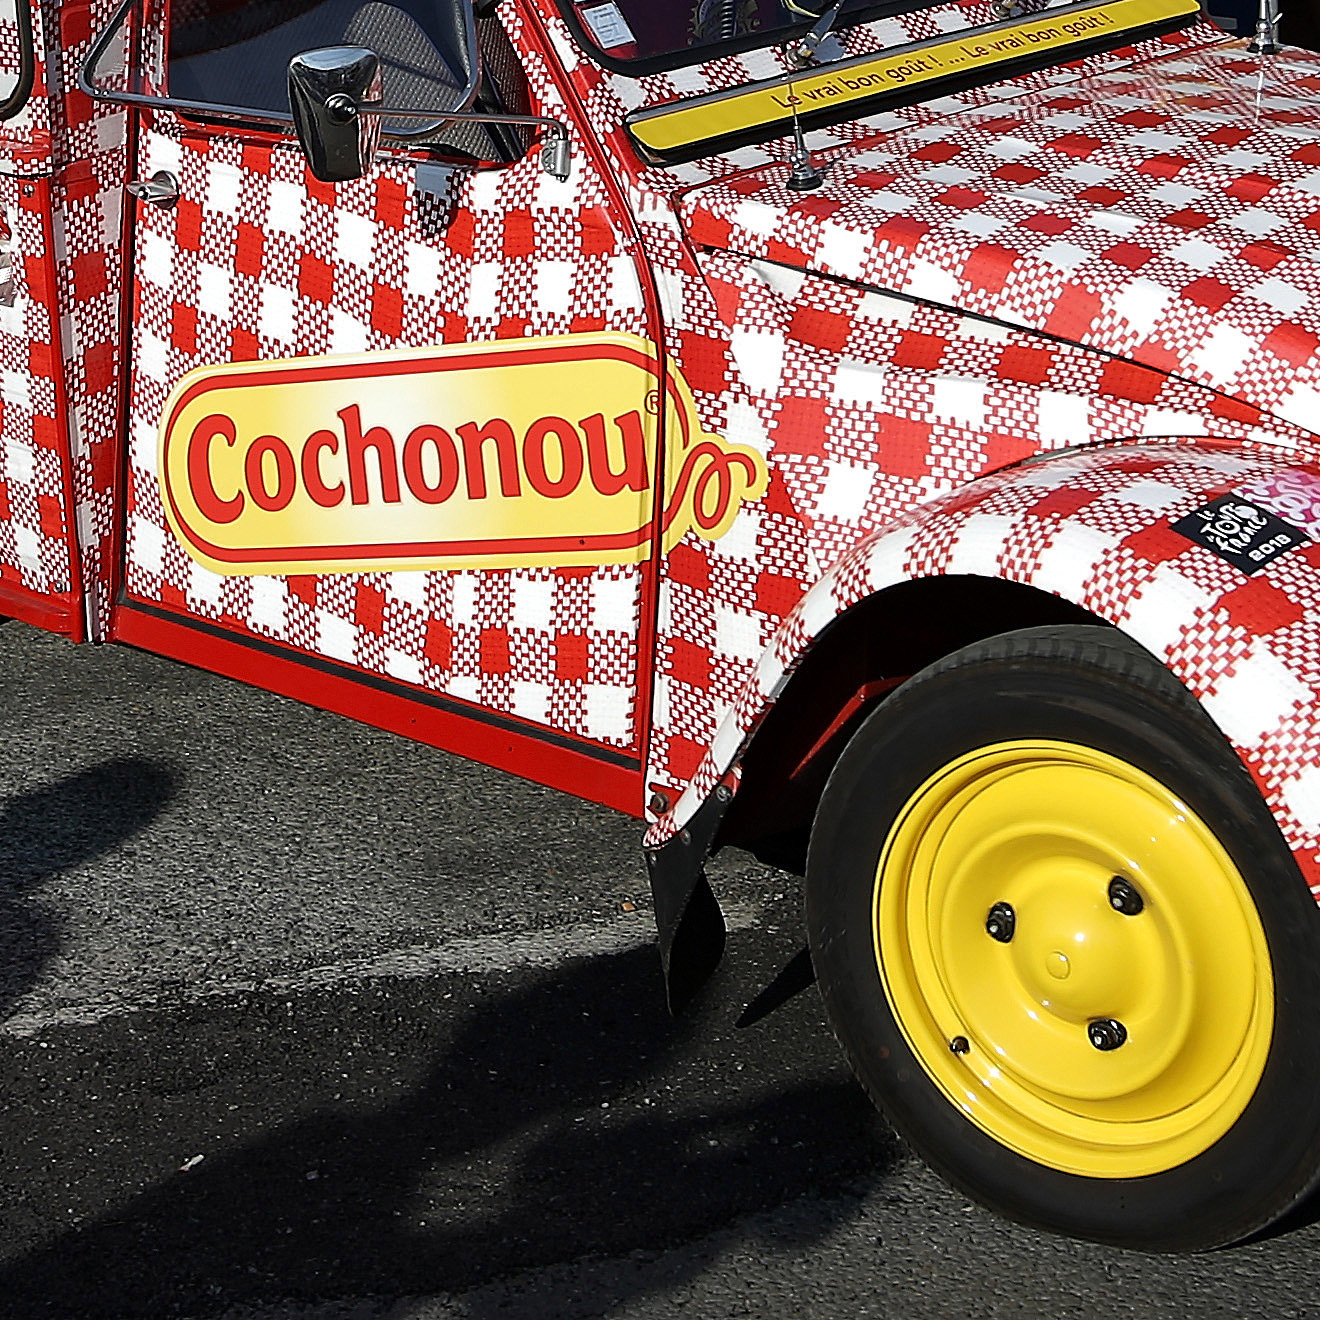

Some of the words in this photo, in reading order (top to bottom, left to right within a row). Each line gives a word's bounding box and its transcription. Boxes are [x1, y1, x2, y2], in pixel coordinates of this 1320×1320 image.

[771, 93, 803, 109] Le
[804, 80, 843, 103] vrai
[839, 71, 881, 92] bon
[884, 57, 934, 84] goût
[959, 45, 991, 60] Le
[990, 31, 1026, 53] vrai
[1021, 22, 1061, 44] bon
[1062, 13, 1105, 38] goût
